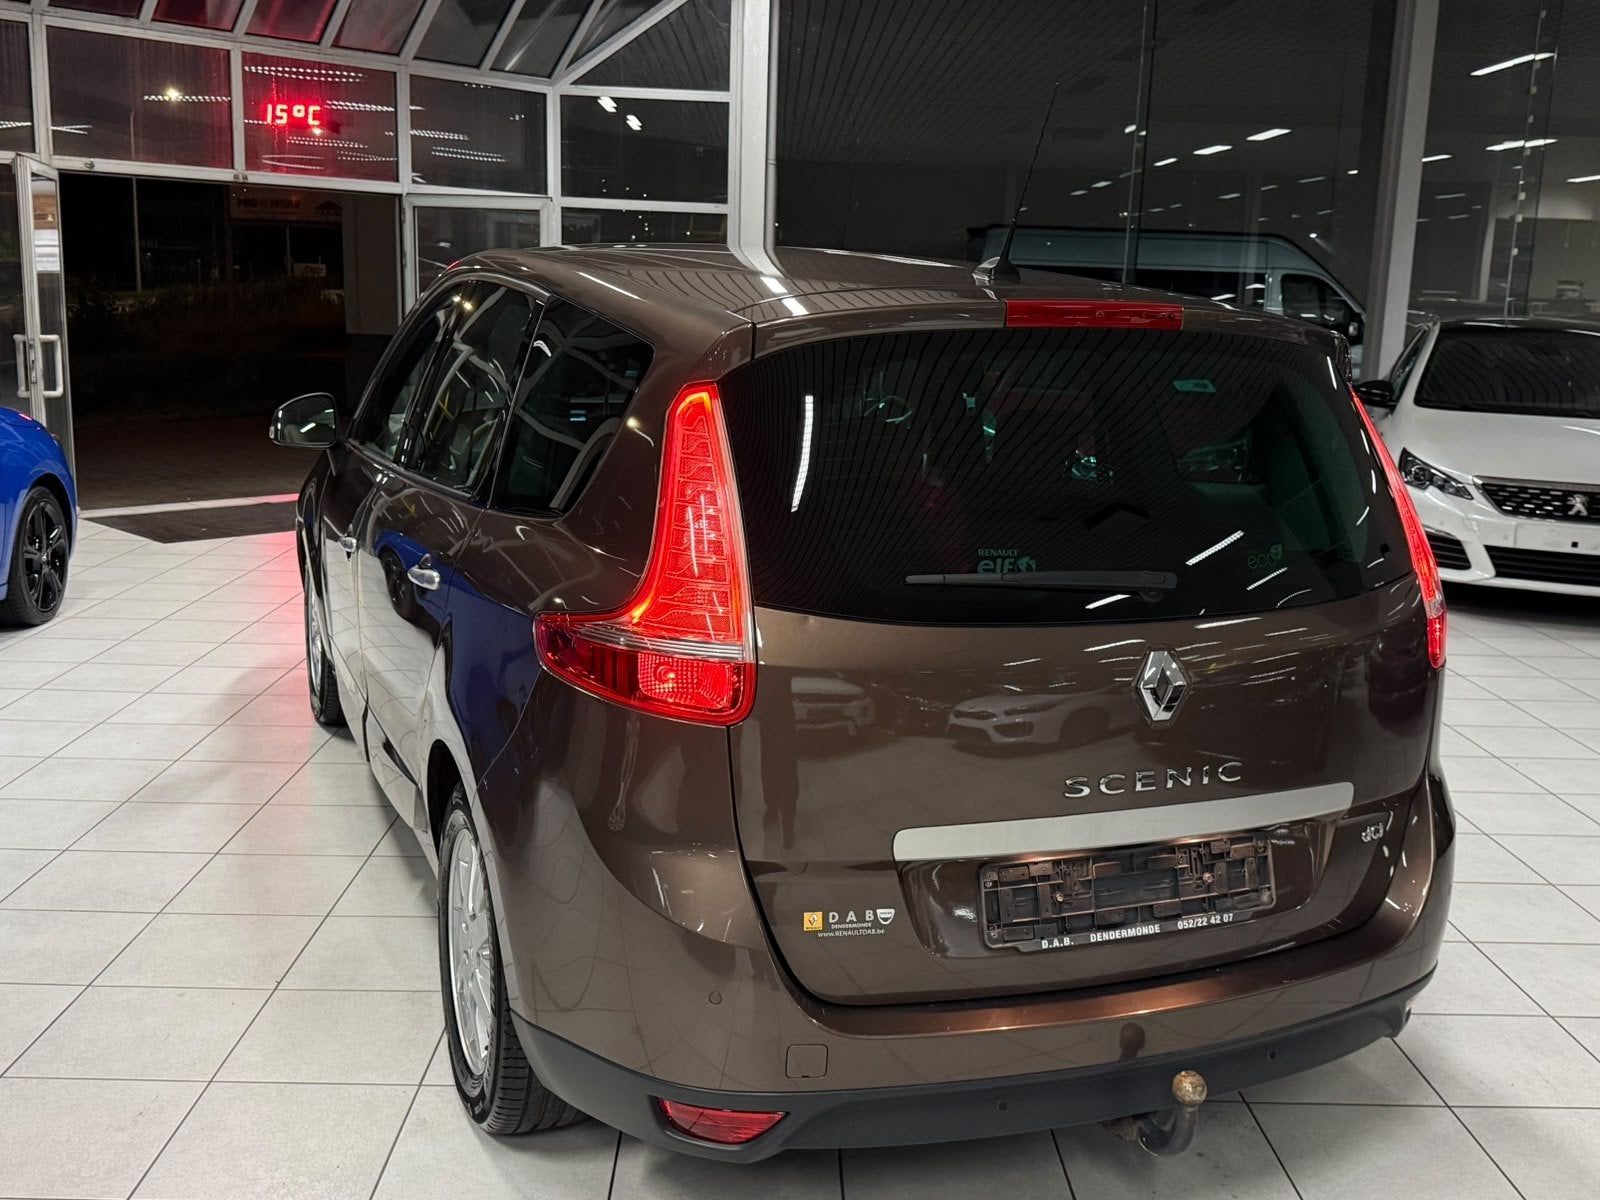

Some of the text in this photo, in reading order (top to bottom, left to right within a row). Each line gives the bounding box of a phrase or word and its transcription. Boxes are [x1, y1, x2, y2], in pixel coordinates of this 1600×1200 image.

[977, 548, 1018, 557] RENAULT
[976, 558, 1016, 574] elf
[1063, 761, 1243, 799] SCENIC
[831, 922, 872, 930] DENDERMONDE
[1041, 913, 1234, 949] D.A.B. DENDERMONDE 052/22 42 07
[817, 928, 886, 938] www.RENAULTDAB.be
